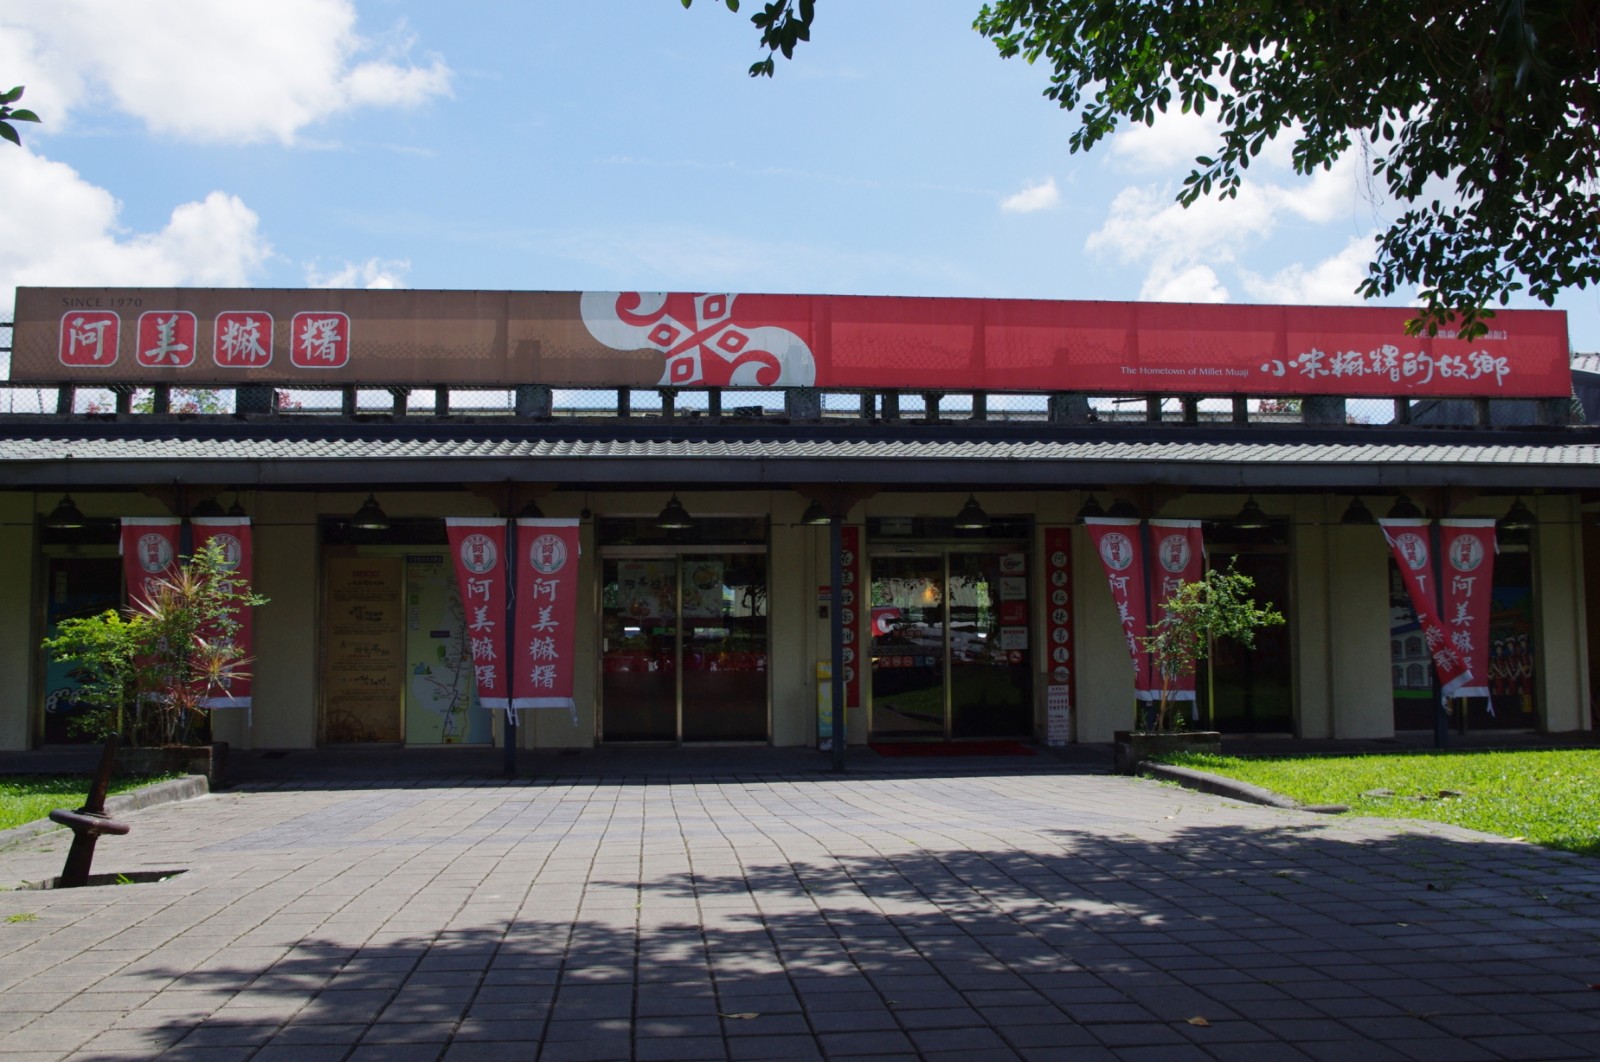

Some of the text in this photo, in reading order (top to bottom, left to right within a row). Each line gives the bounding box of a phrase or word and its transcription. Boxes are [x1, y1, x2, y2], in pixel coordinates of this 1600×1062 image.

[62, 297, 143, 308] SINCE 1970
[1120, 366, 1249, 378] The Hometown of Millet Muaji
